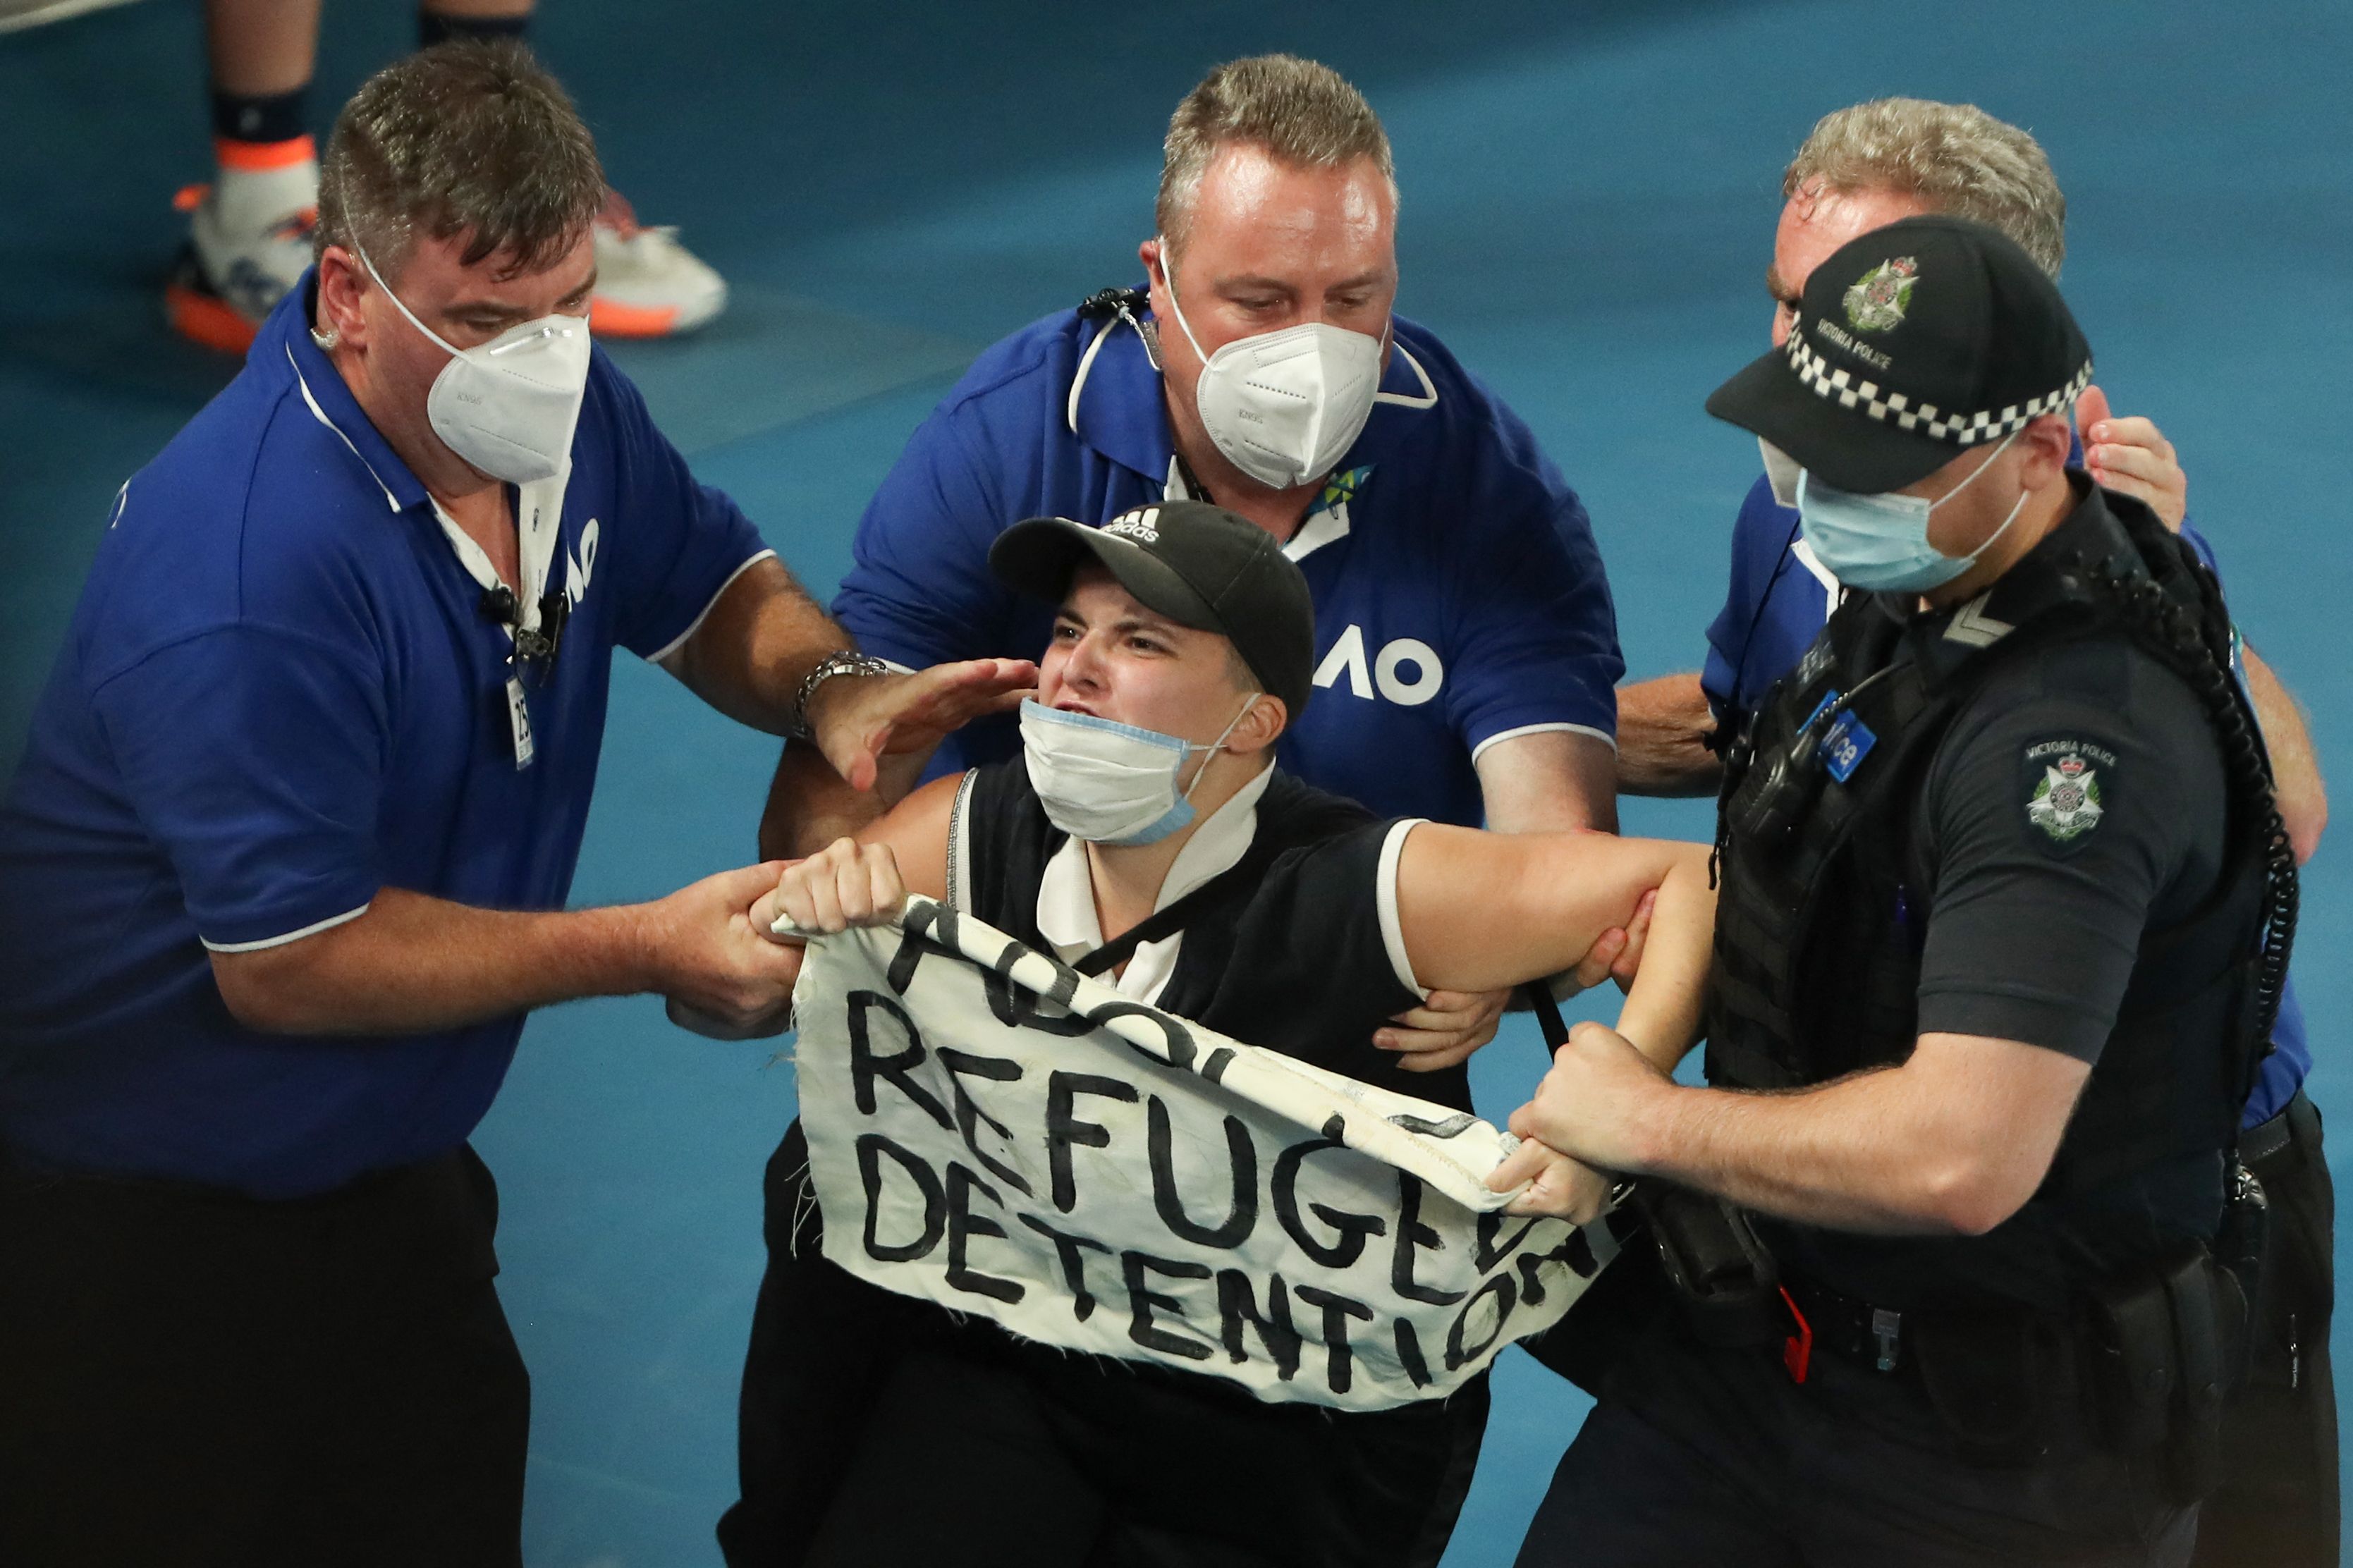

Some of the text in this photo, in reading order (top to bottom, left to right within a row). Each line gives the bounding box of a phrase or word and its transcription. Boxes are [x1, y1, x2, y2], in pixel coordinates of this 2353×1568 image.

[1817, 318, 1893, 370] VICTORIA POLICE
[1312, 624, 1443, 706] AO
[2026, 740, 2116, 766] VICTORIA POLICE
[856, 1134, 1598, 1394] DETENTION
